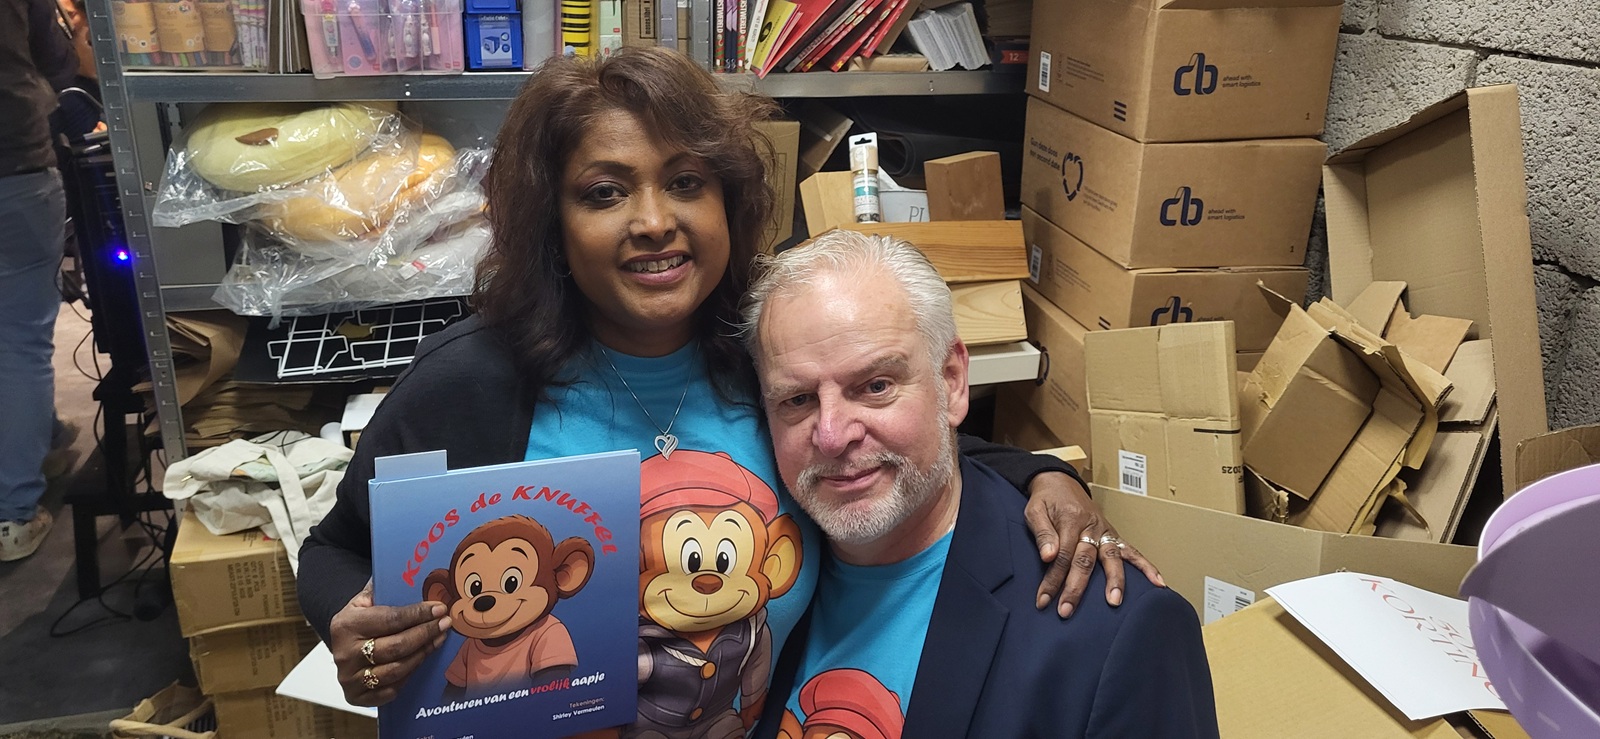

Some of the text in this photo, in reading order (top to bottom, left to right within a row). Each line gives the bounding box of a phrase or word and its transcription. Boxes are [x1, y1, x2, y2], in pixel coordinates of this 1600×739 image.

[1009, 53, 1019, 61] 12
[1174, 52, 1218, 96] cb
[1160, 186, 1203, 226] cb
[402, 507, 460, 587] KOOS
[470, 492, 502, 514] de
[1430, 616, 1480, 660] 50
[415, 672, 605, 719] Avonturen van een vrolijk aapje
[569, 697, 605, 708] Tekeningen:
[573, 705, 605, 716] Vermeulen
